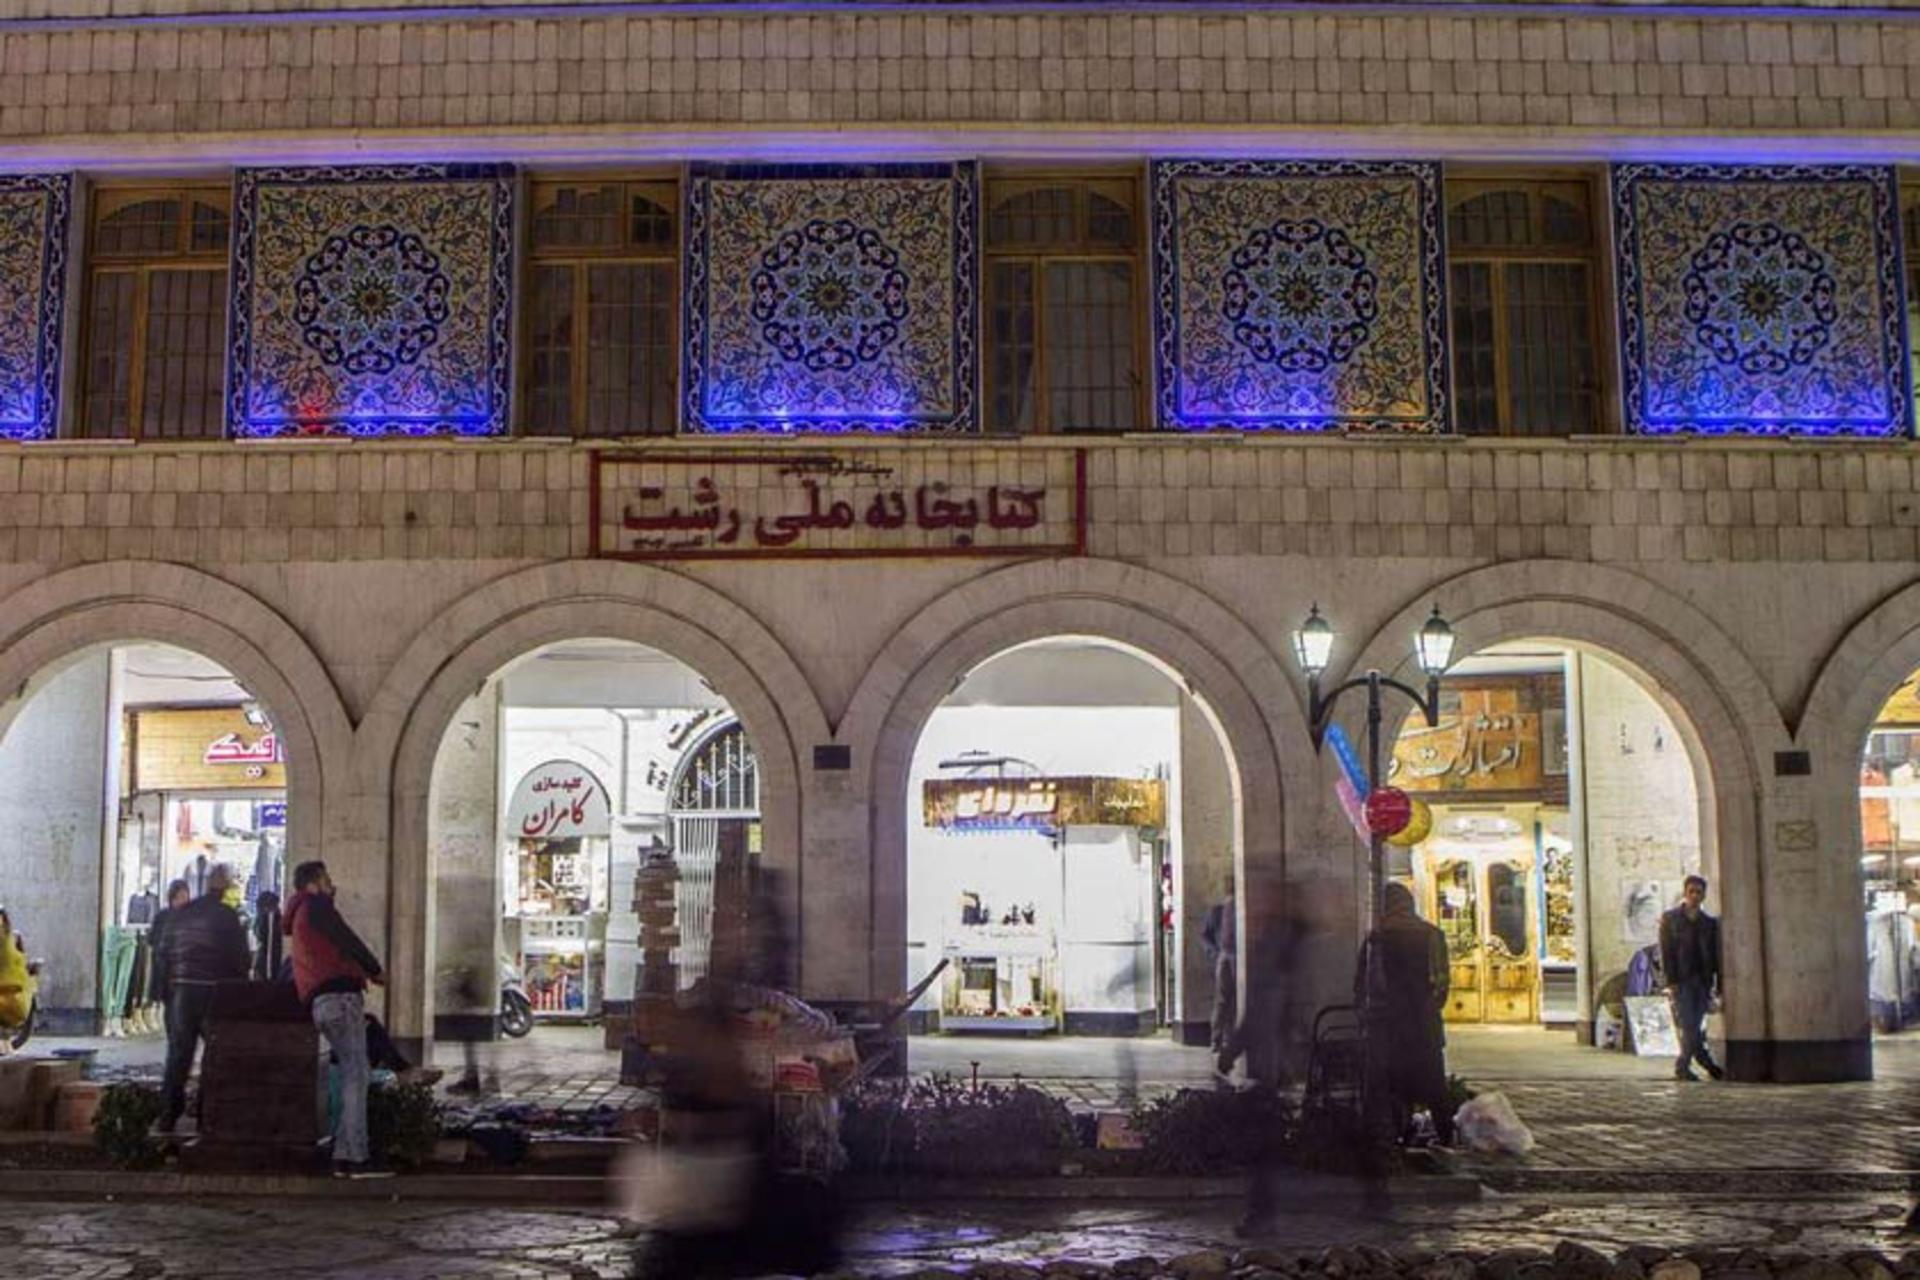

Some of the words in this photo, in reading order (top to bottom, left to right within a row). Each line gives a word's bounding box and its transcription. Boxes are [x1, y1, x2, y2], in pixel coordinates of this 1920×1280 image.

[622, 476, 740, 542] رشت
[754, 479, 854, 547] ملی
[865, 481, 1046, 547] کتابخانه
[522, 786, 595, 836] کامران
[531, 776, 560, 793] سازی
